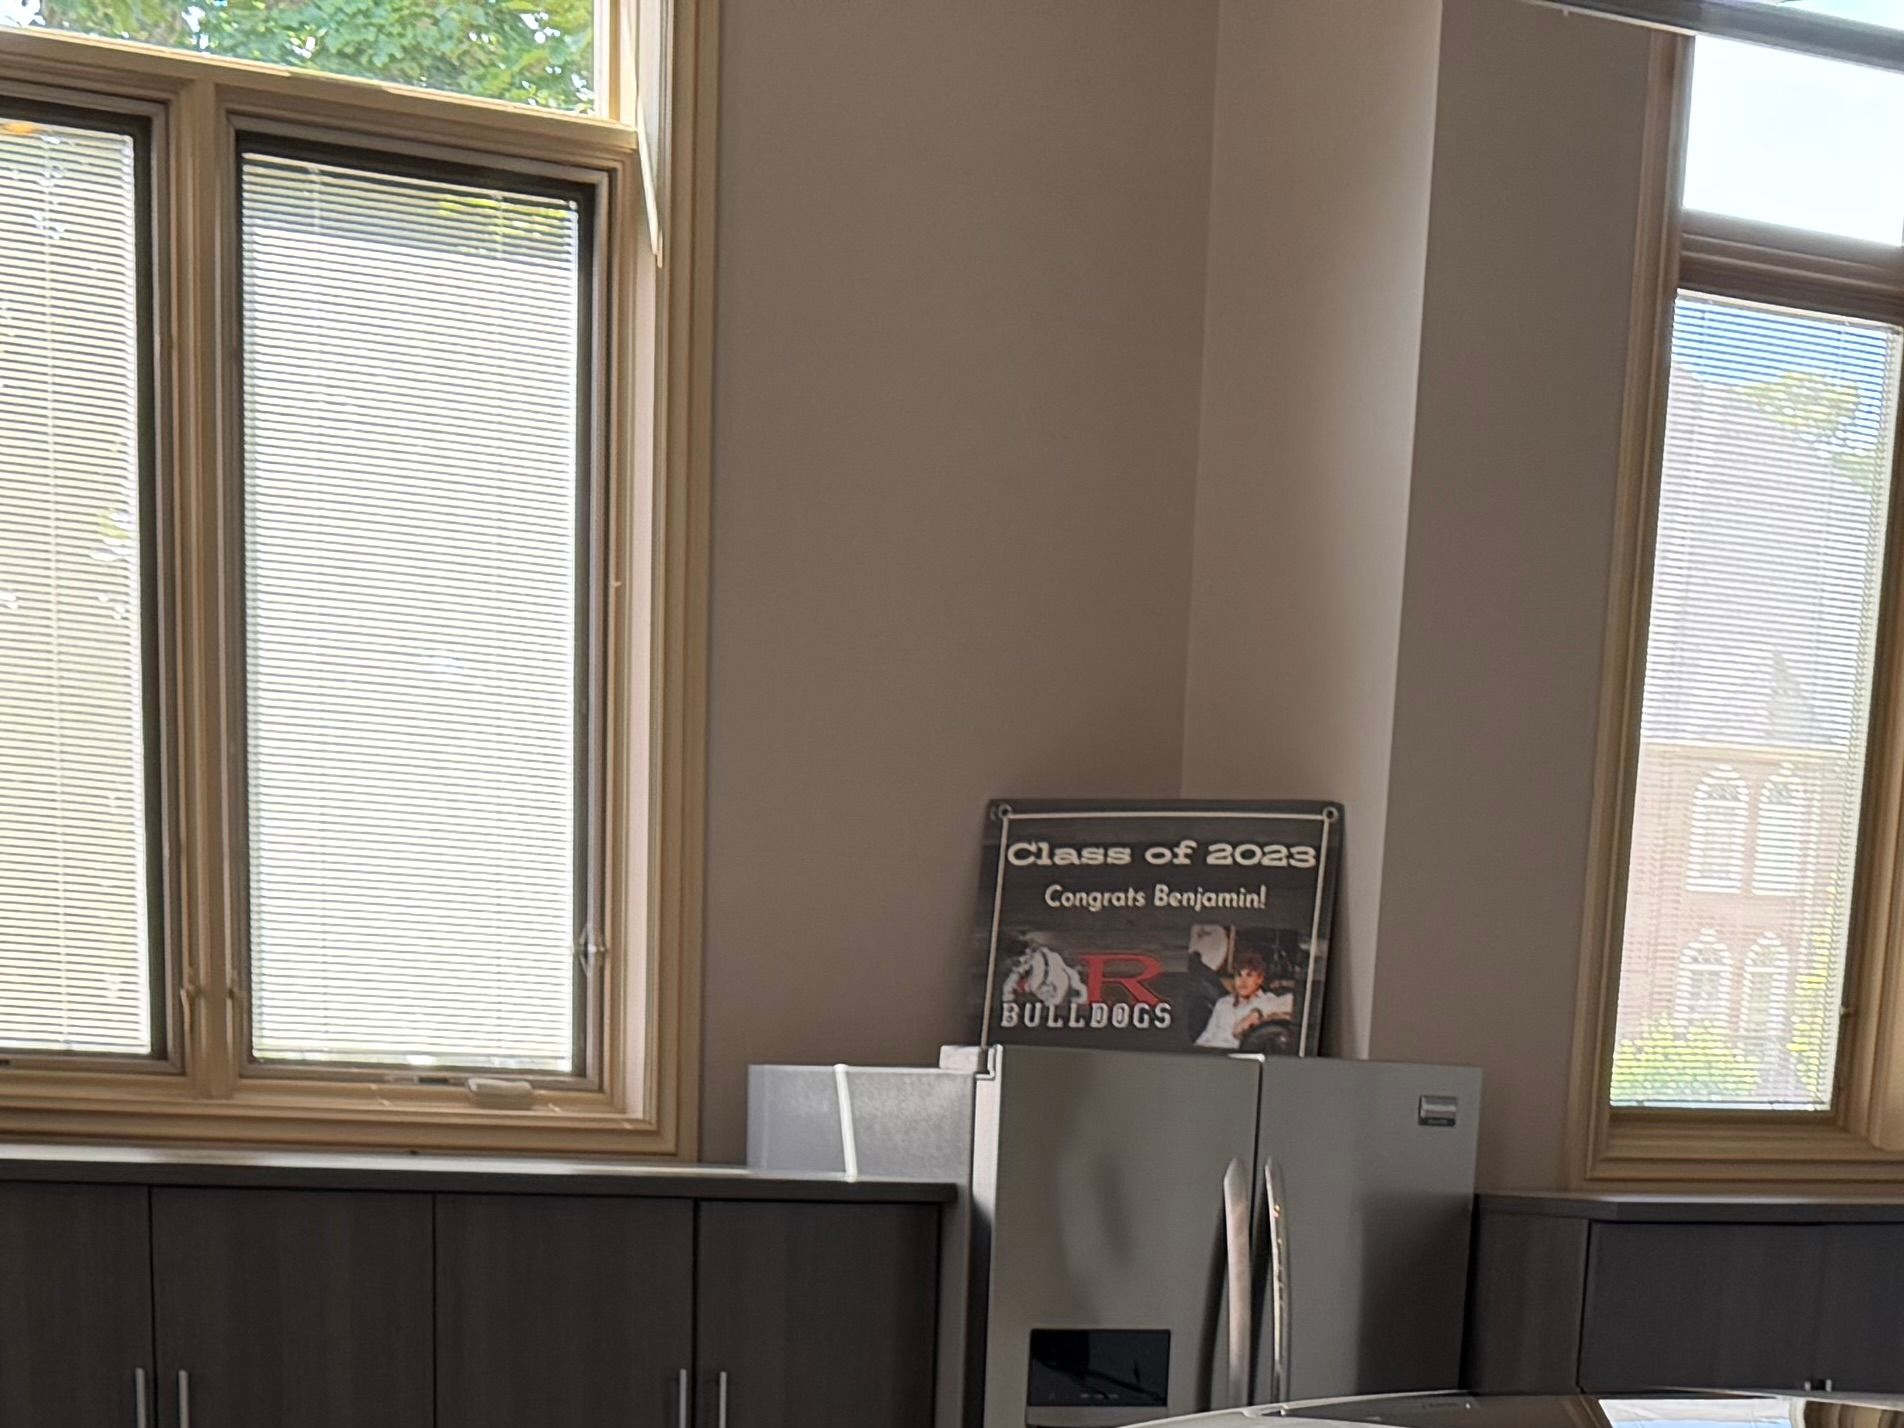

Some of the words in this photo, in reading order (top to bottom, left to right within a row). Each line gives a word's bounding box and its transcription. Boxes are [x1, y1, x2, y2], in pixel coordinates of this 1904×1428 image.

[1007, 842, 1132, 867] Class
[1144, 840, 1197, 866] of
[1206, 843, 1317, 868] 2023
[1044, 884, 1146, 912] Congrats
[1154, 884, 1267, 912] Benjamin!
[1078, 951, 1171, 1006] R
[1000, 1002, 1172, 1029] BULLDOGS
